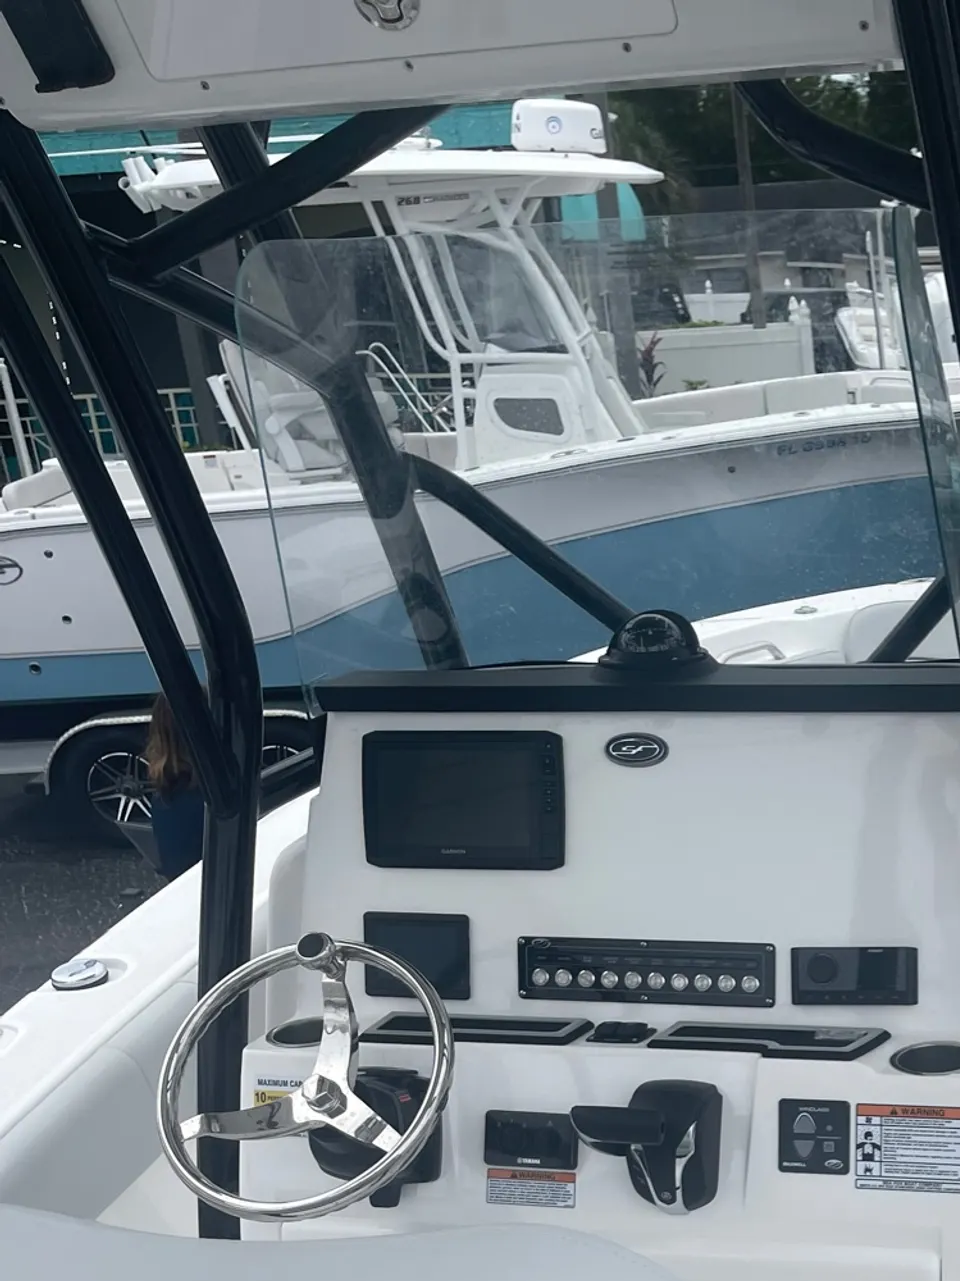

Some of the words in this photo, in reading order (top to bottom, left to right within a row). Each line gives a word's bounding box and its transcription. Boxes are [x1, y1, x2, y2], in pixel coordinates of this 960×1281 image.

[257, 1078, 288, 1087] MAXIMUM
[255, 1091, 267, 1103] 10
[901, 1108, 945, 1116] WARNING
[518, 1171, 556, 1180] WARNING
